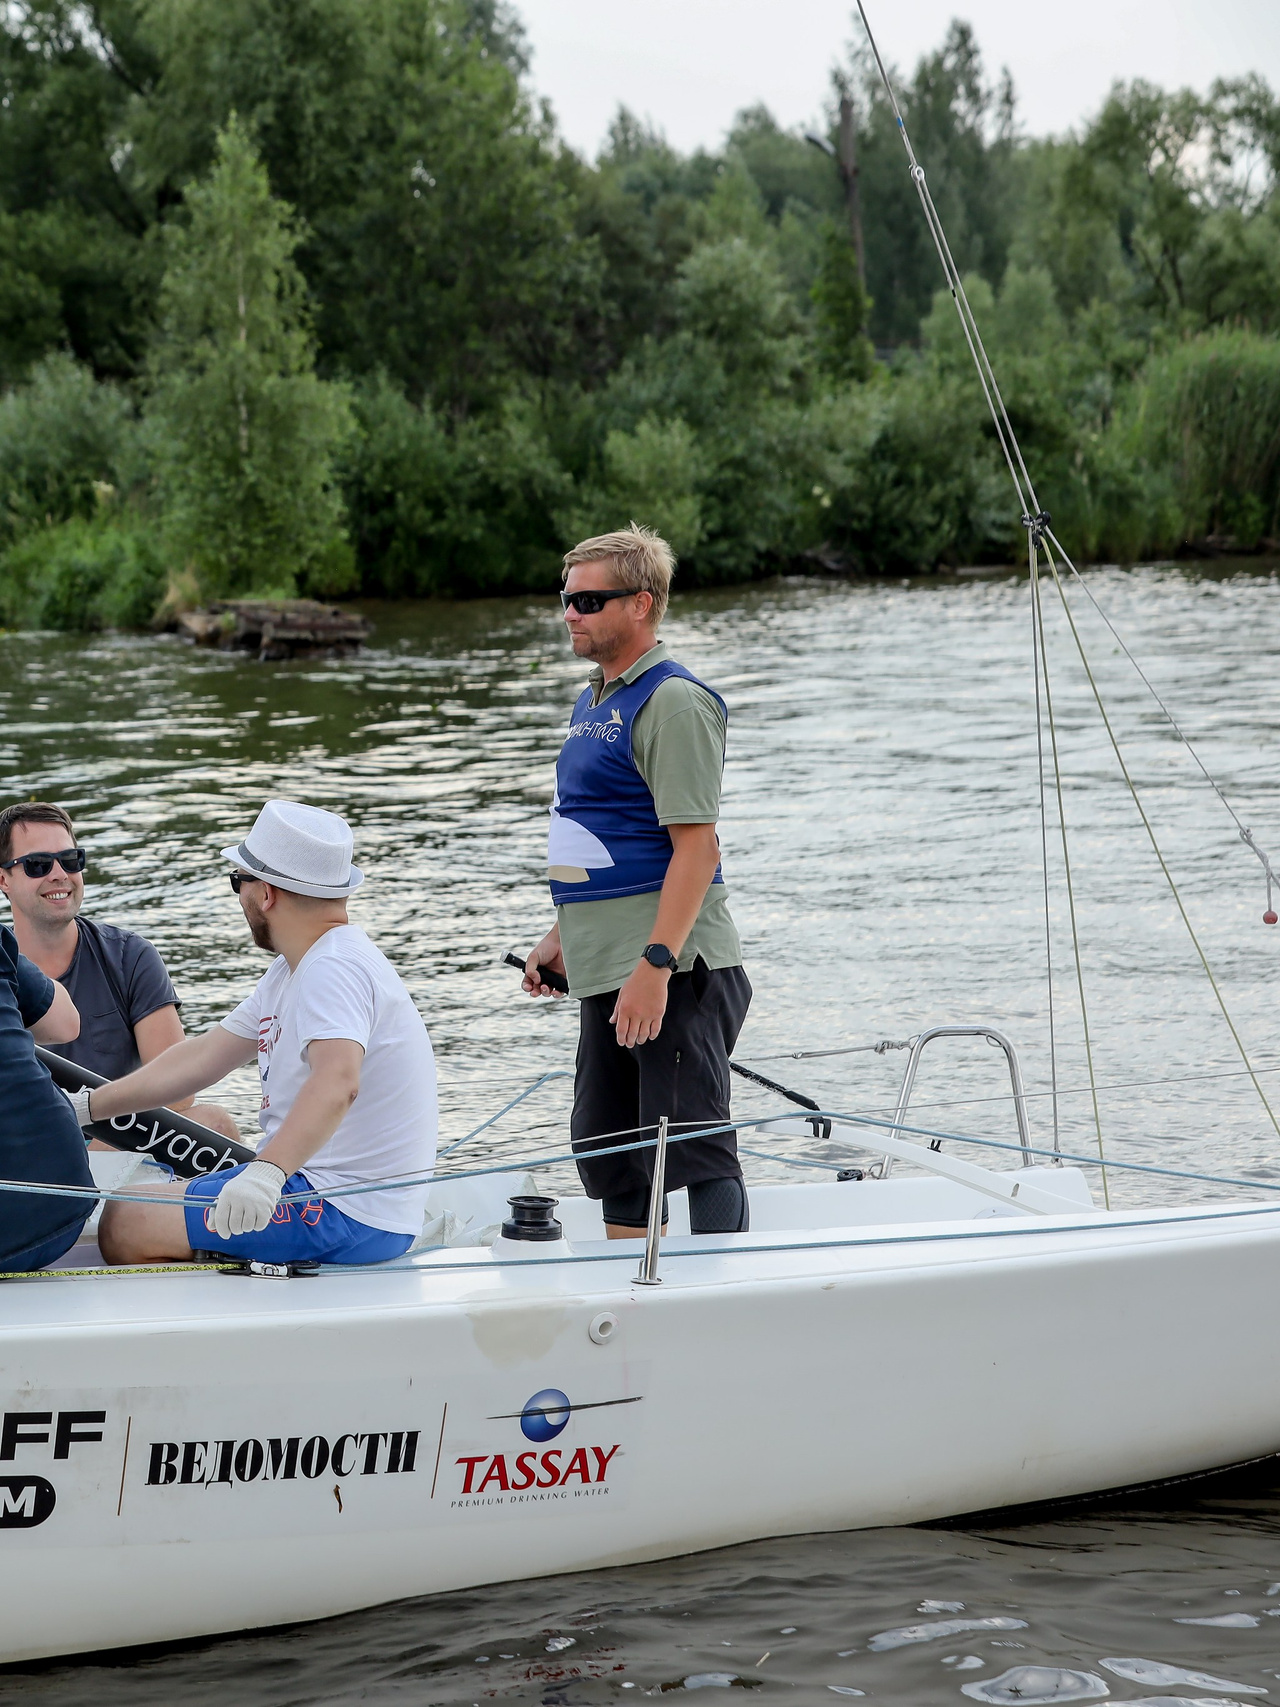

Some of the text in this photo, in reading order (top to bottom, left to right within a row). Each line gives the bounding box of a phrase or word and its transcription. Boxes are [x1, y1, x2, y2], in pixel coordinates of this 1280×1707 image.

[144, 1430, 422, 1490] ВЕДОМОСТИ
[455, 1444, 621, 1494] TASSAY
[451, 1487, 610, 1508] PREMIUM DRINKING WATER
